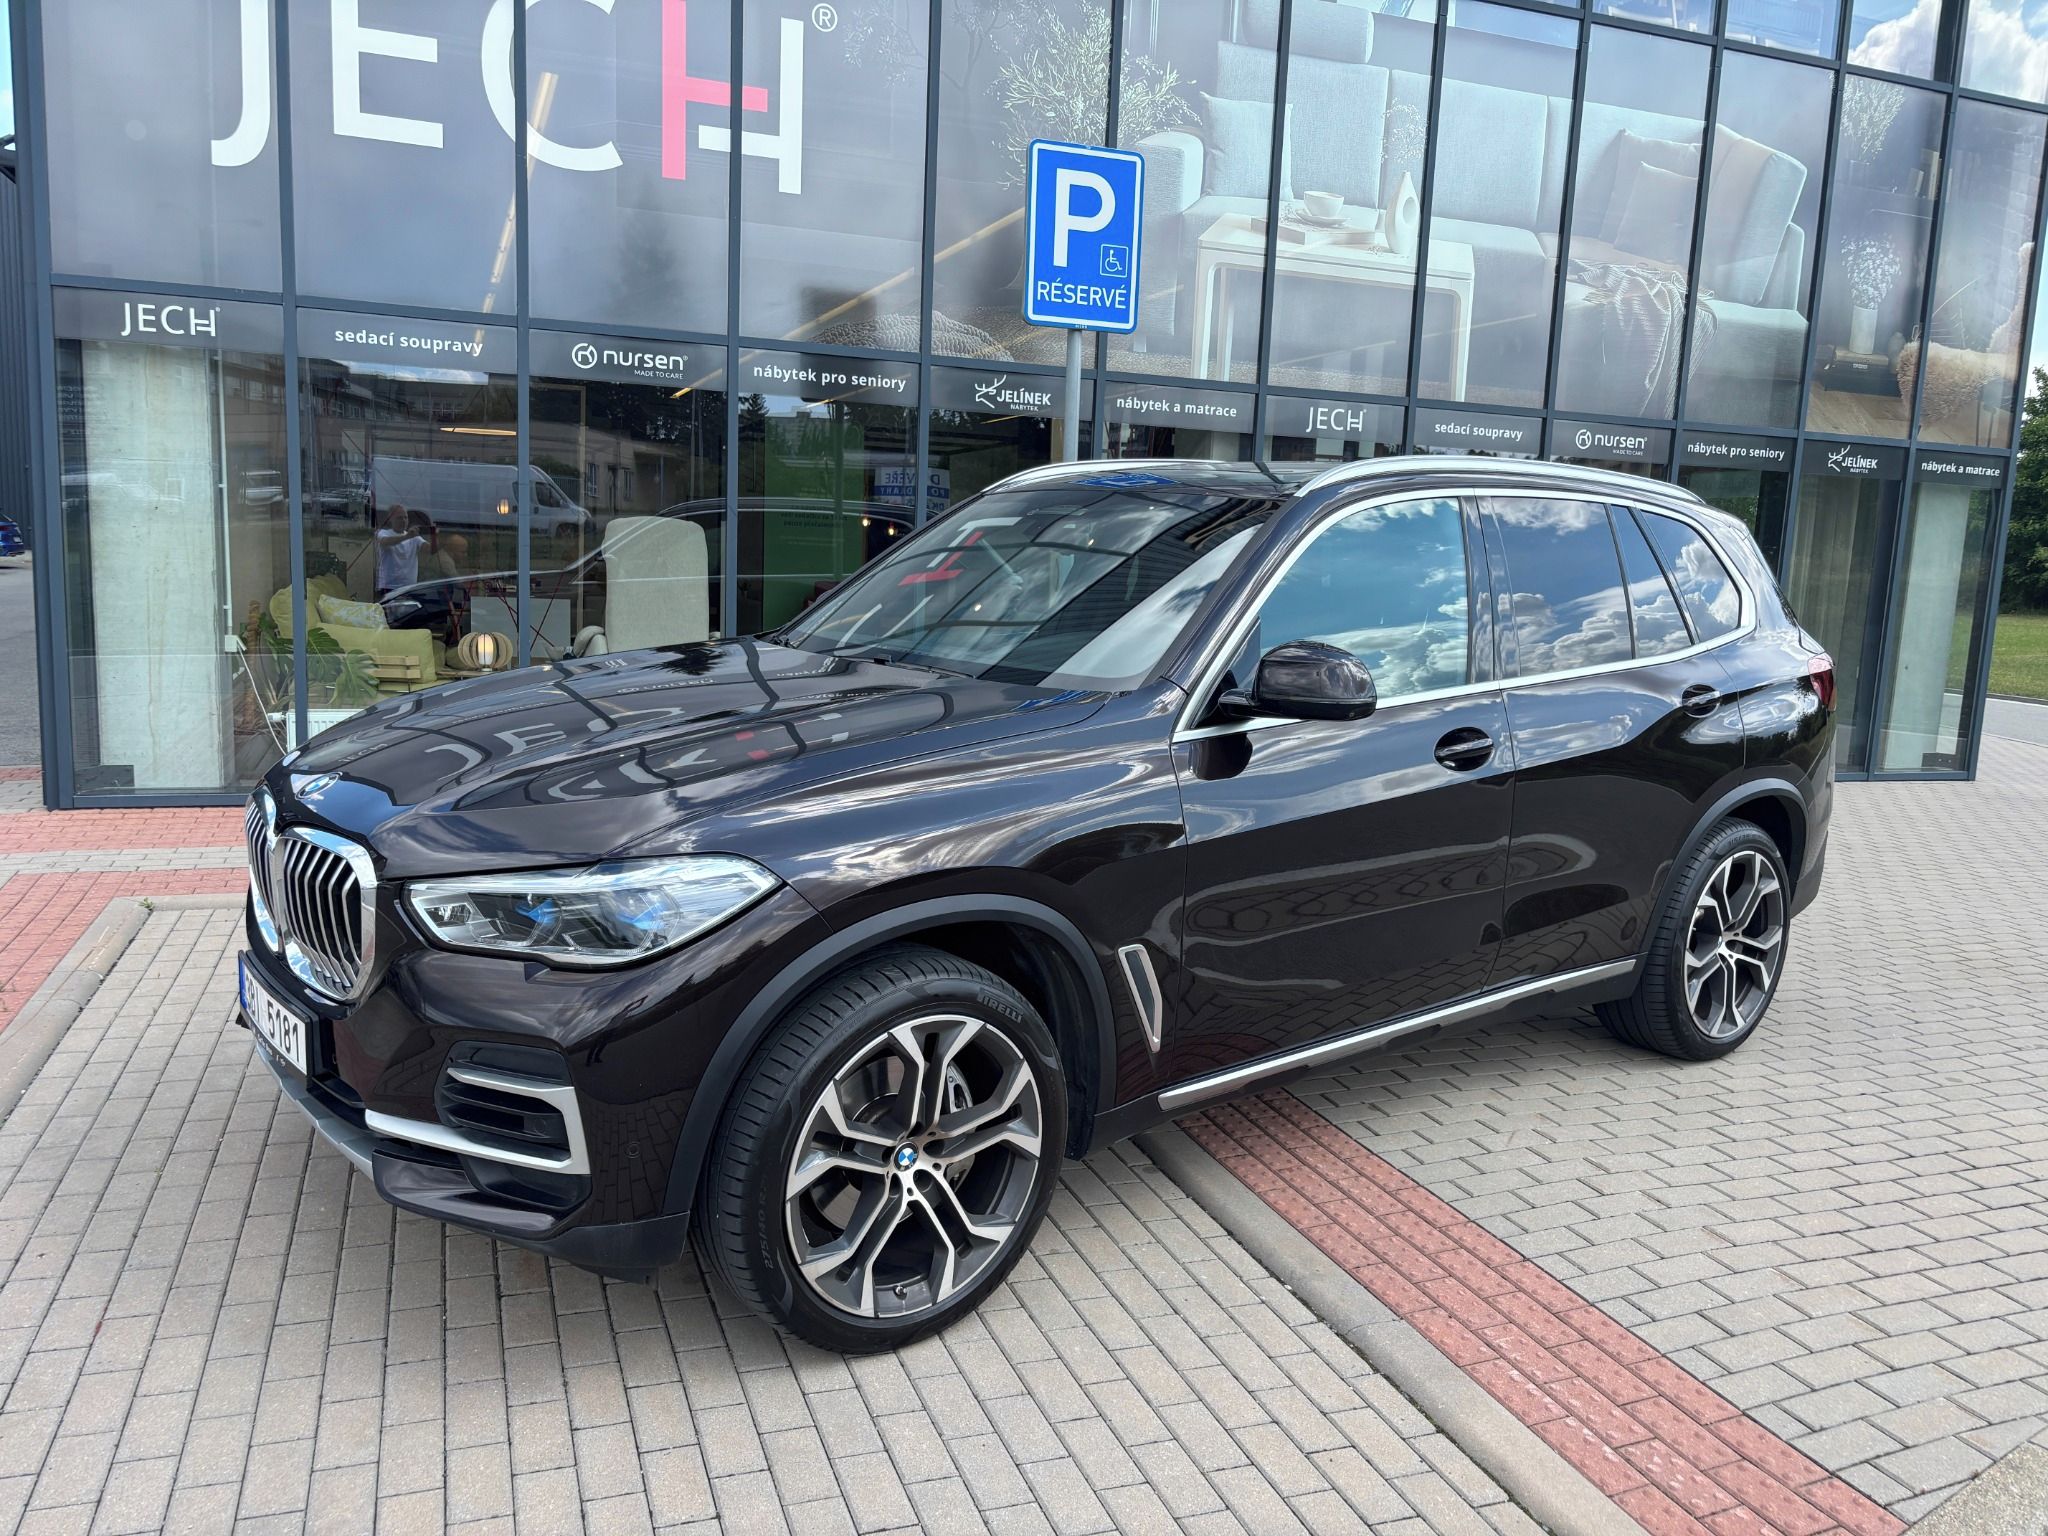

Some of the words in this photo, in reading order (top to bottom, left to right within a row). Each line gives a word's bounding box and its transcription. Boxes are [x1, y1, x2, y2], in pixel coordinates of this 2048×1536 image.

[210, 0, 804, 195] JECH
[1053, 168, 1116, 268] P
[1036, 277, 1127, 309] RÉSERVÉ
[121, 302, 217, 337] JECH
[335, 329, 395, 347] sedací
[399, 335, 484, 357] soupravy
[603, 350, 684, 371] nursen
[666, 372, 684, 380] CARE
[753, 364, 817, 382] nábytek
[821, 372, 847, 386] pro
[851, 375, 907, 392] seniory
[996, 388, 1052, 406] JELÍNEK
[1116, 396, 1170, 413] nábytek
[1173, 403, 1181, 413] a
[1185, 404, 1237, 417] matrace
[1305, 407, 1364, 433] JECH
[1434, 422, 1471, 435] sedací
[1473, 426, 1523, 442] soupravy
[1594, 434, 1645, 449] nursen
[1687, 442, 1728, 456] nábytek
[1729, 446, 1747, 458] pro
[1749, 448, 1785, 461] seniory
[1841, 454, 1879, 469] JELÍNEK
[1921, 461, 1957, 474] nábytek
[1958, 465, 1964, 474] a
[1965, 466, 2001, 477] matrace
[267, 999, 300, 1063] 5181
